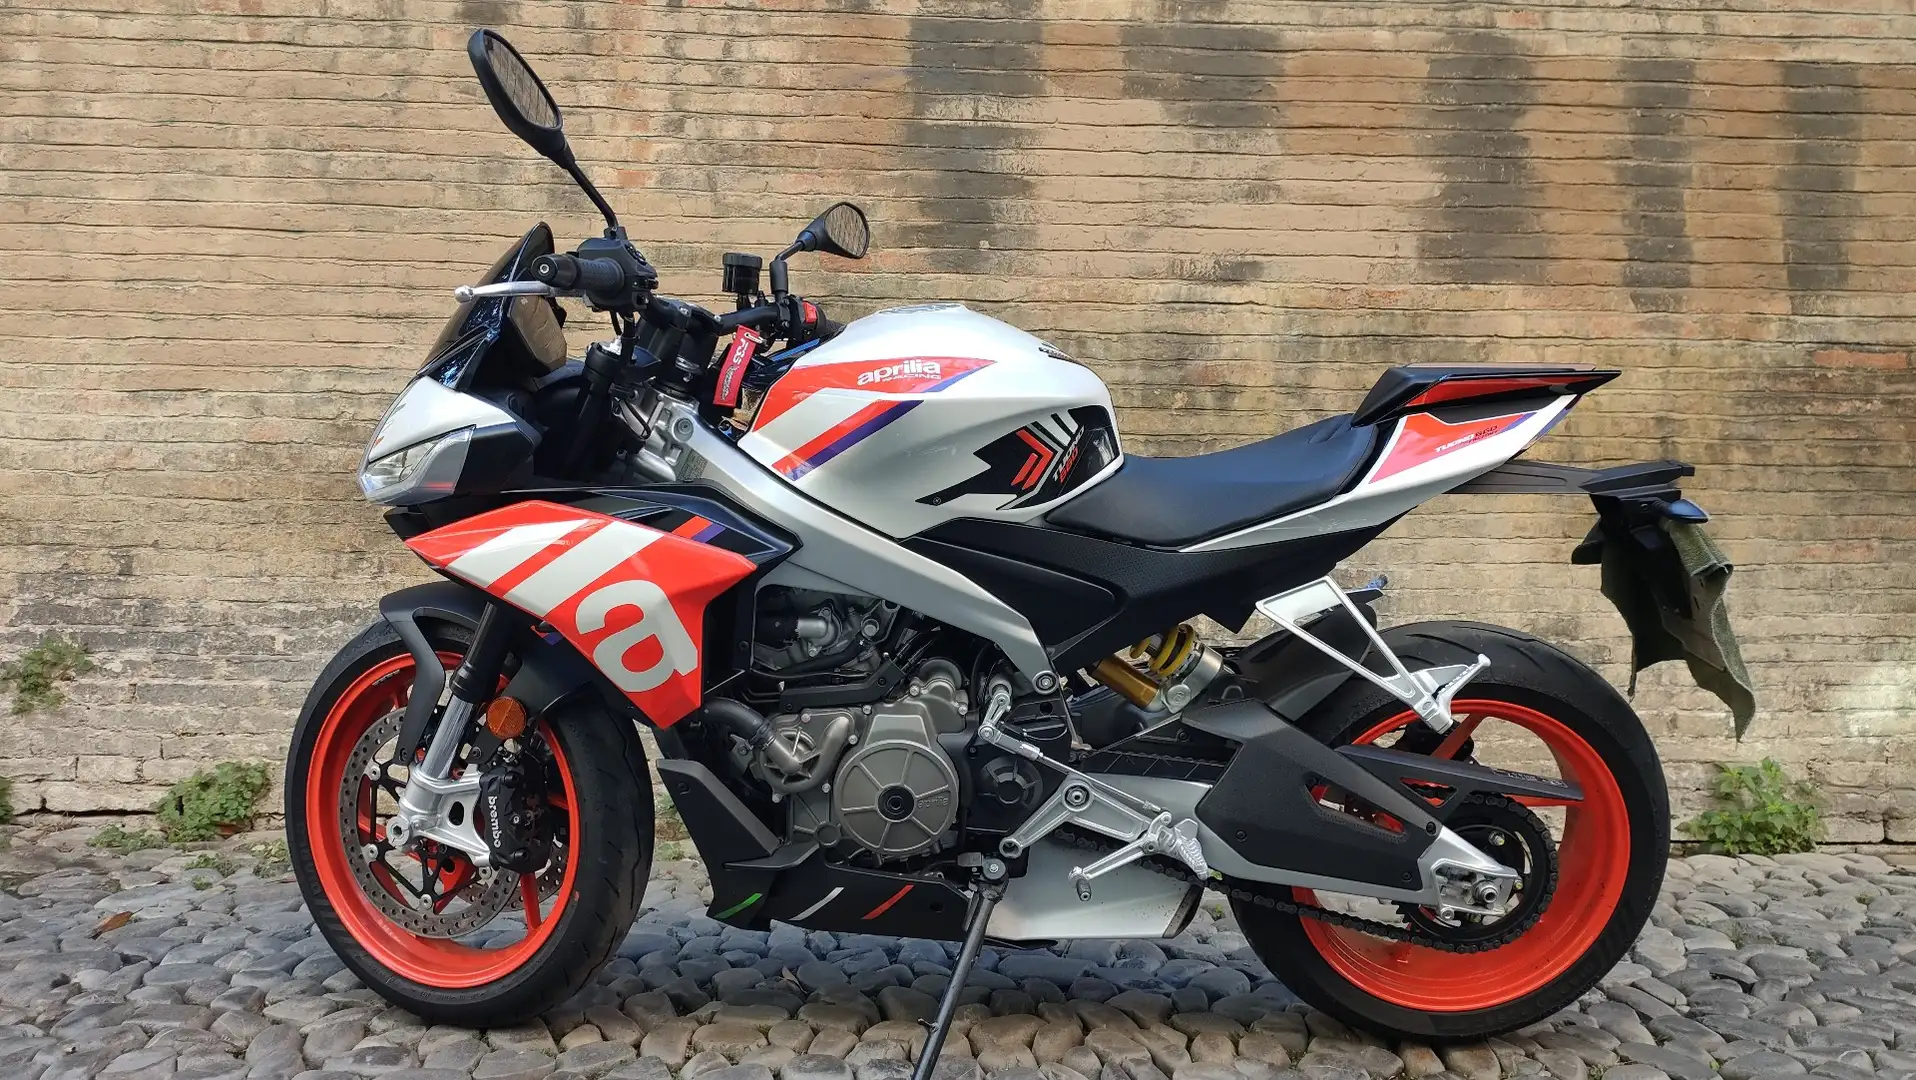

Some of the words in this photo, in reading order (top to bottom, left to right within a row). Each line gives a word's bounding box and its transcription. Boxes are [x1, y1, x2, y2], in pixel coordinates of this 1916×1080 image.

[857, 359, 942, 386] aprilia
[881, 373, 942, 382] RACING
[1052, 425, 1085, 482] TUONO
[1434, 433, 1475, 453] TUONO
[575, 579, 699, 693] a
[488, 796, 502, 848] brembo
